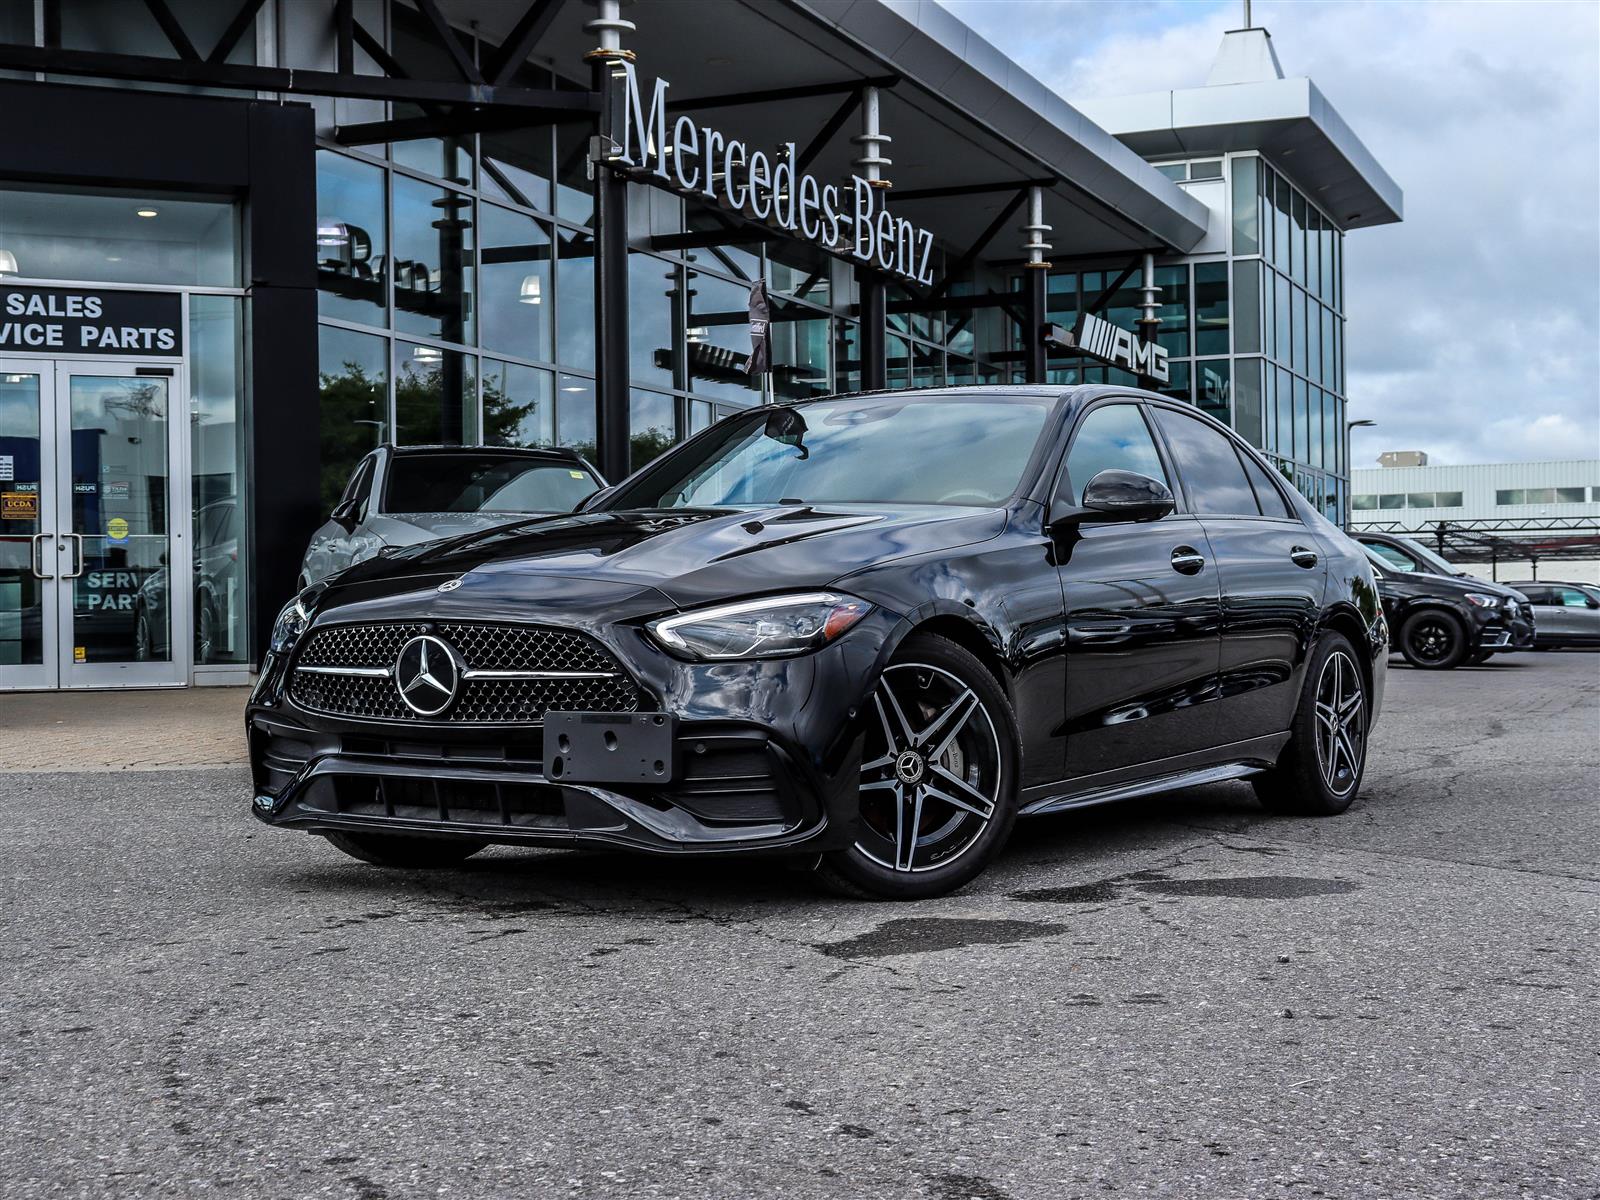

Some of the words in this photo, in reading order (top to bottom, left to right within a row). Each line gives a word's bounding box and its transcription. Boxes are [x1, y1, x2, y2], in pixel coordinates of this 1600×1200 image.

[619, 58, 935, 287] Mercedes-Benz
[6, 293, 103, 319] SALES
[80, 326, 176, 350] PARTS
